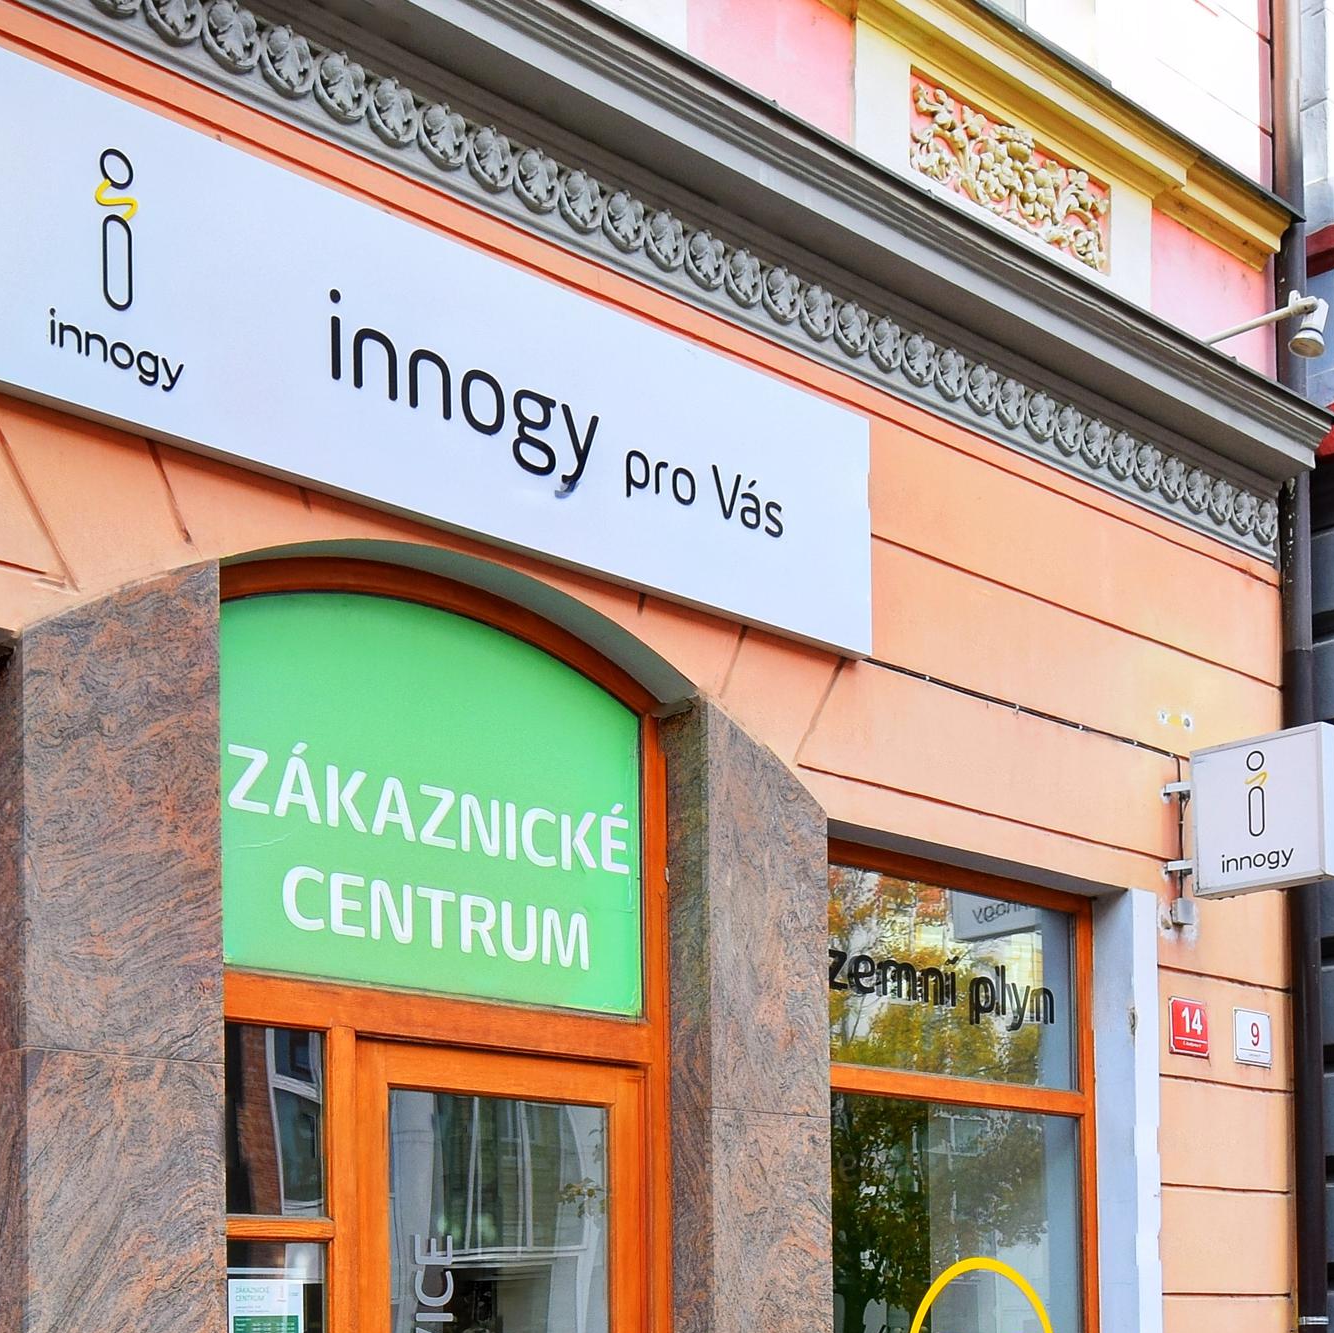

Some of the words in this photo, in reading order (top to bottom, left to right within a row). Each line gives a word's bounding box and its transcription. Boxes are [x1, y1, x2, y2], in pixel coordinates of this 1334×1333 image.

[49, 307, 185, 393] innogy
[331, 288, 599, 497] innogy
[626, 448, 697, 506] pro
[711, 463, 785, 539] Vás
[226, 741, 630, 876] ZÁKAZNICKÉ
[1221, 847, 1295, 874] innogy
[281, 865, 590, 972] CENTRUM
[969, 964, 1055, 1032] plyn
[1181, 1006, 1203, 1036] 14
[1250, 1022, 1260, 1047] 9
